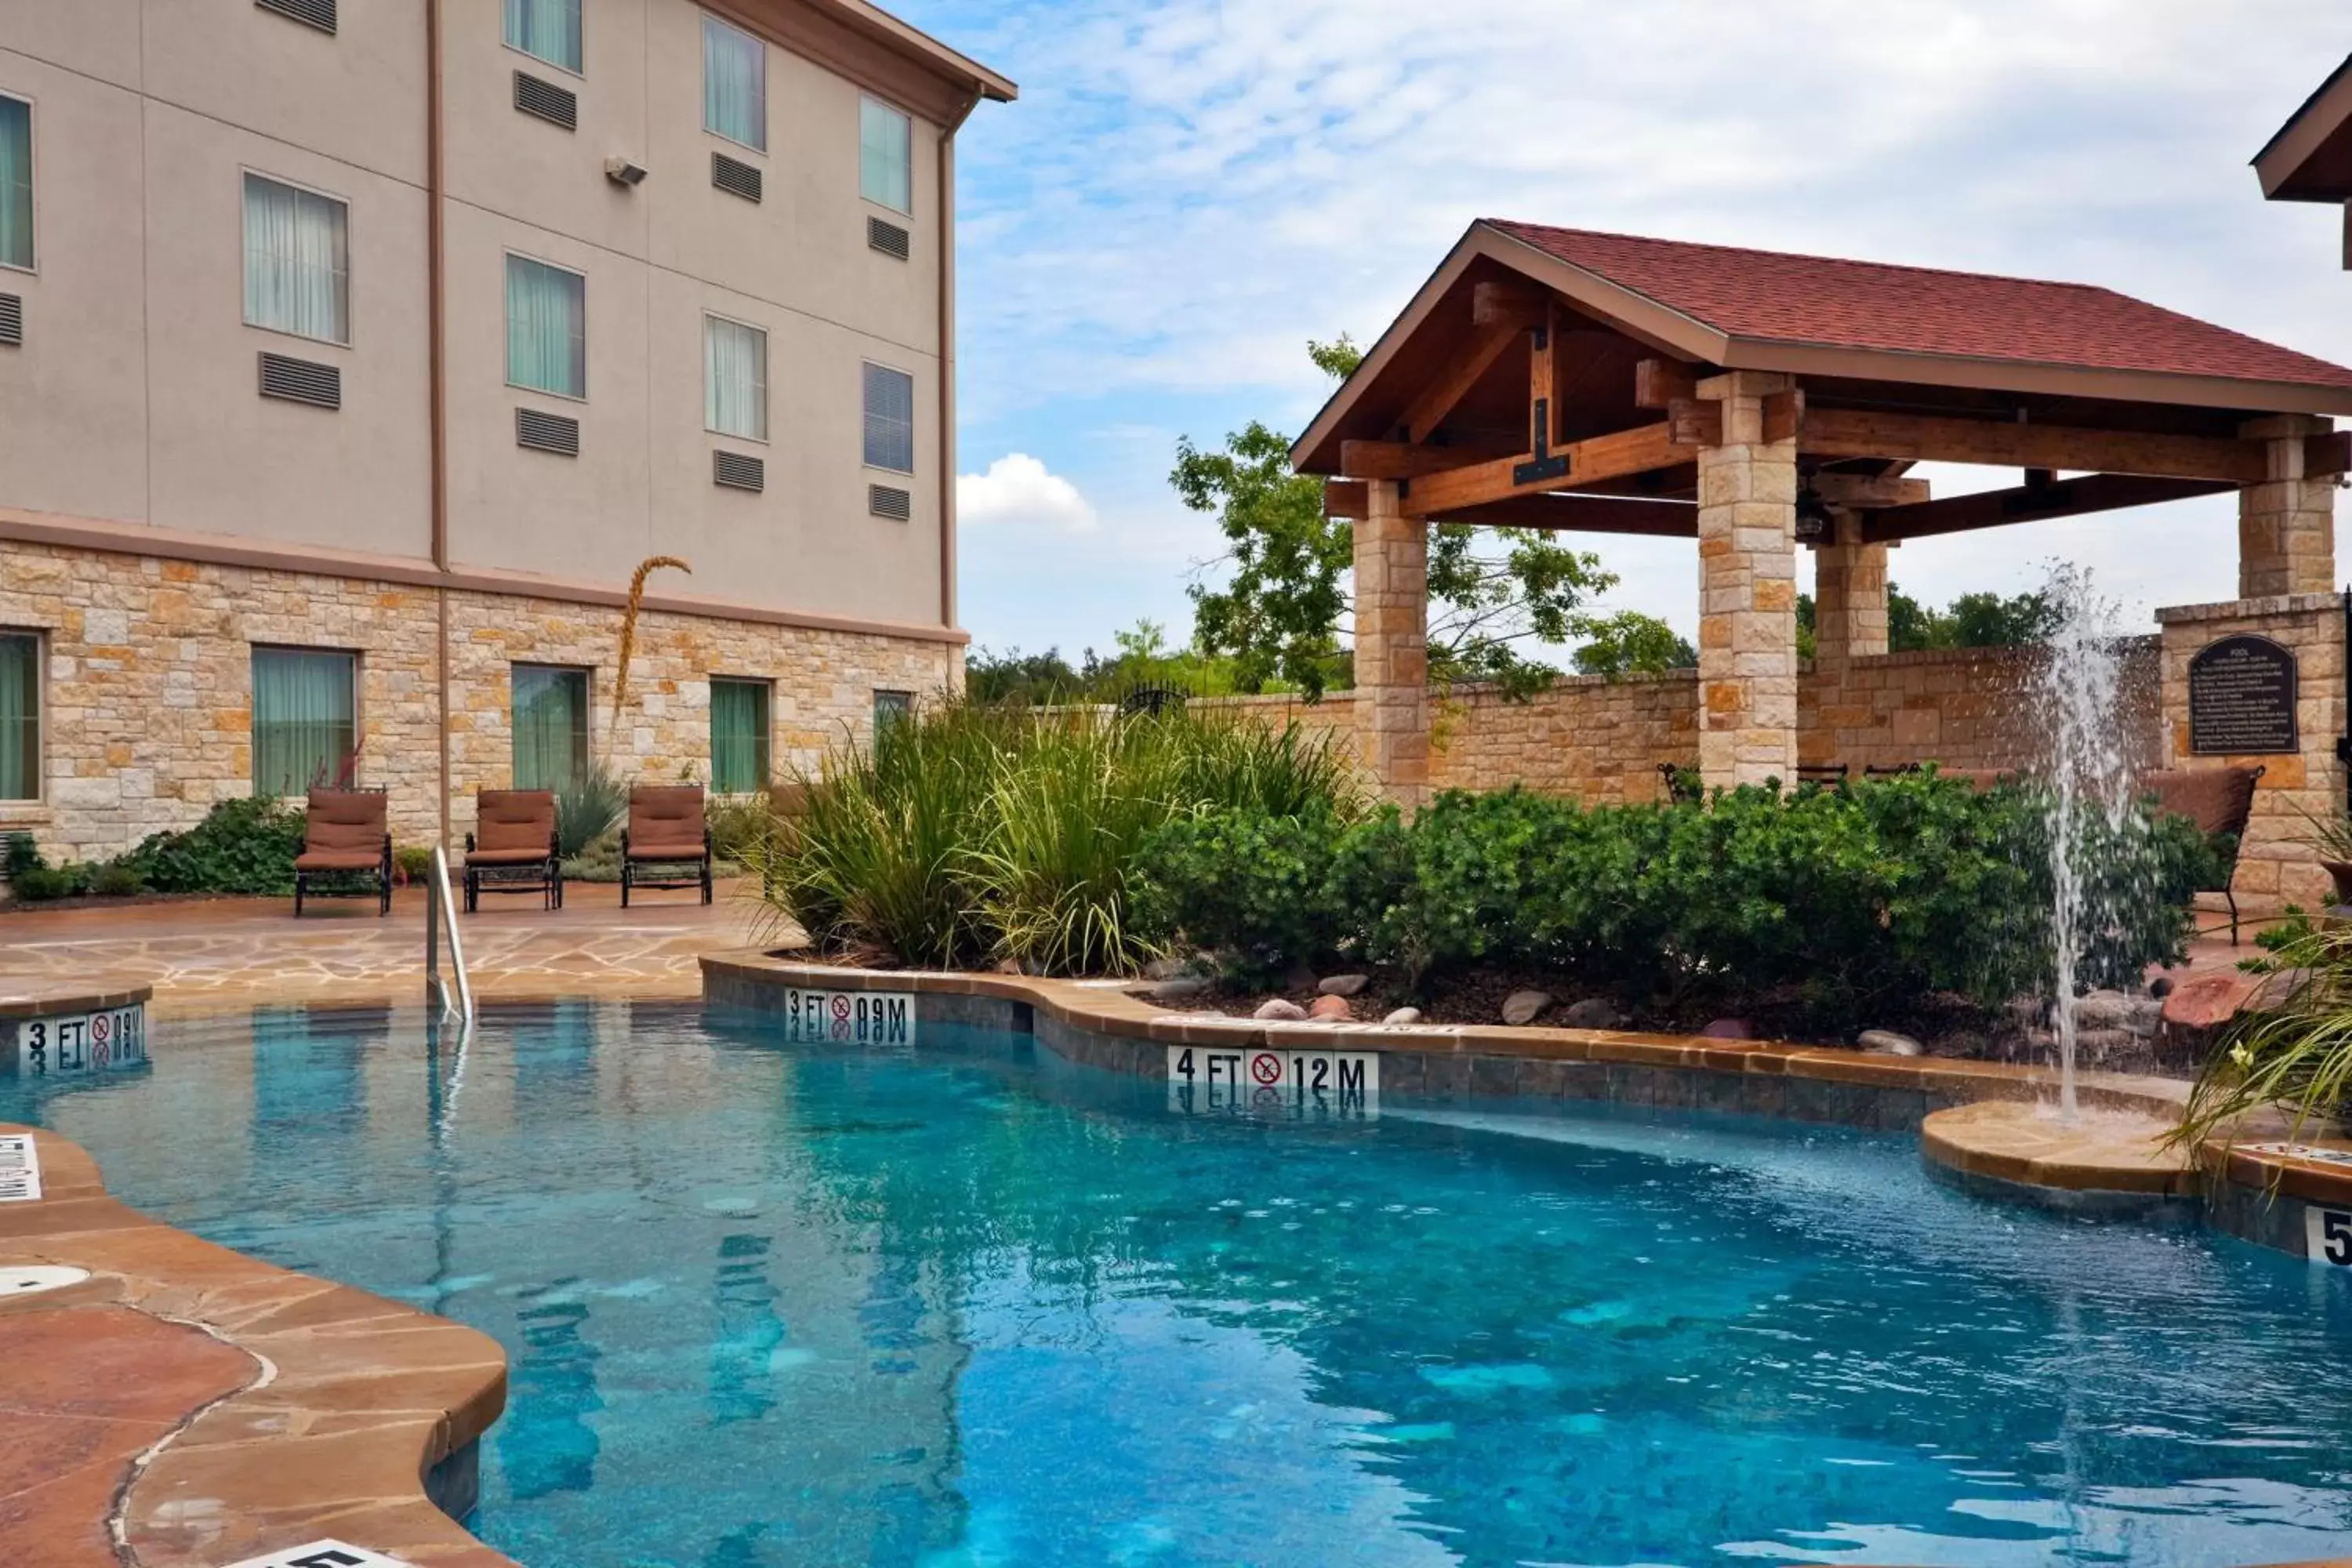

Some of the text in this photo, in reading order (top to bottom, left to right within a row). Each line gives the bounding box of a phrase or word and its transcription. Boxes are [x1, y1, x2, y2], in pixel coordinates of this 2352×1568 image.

[790, 991, 800, 1014] 3
[806, 996, 825, 1018] FT
[30, 1023, 46, 1050] 3
[59, 1022, 85, 1047] FT
[1177, 1049, 1196, 1081] 4
[1207, 1054, 1241, 1084] FT
[2324, 1210, 2352, 1266] 5
